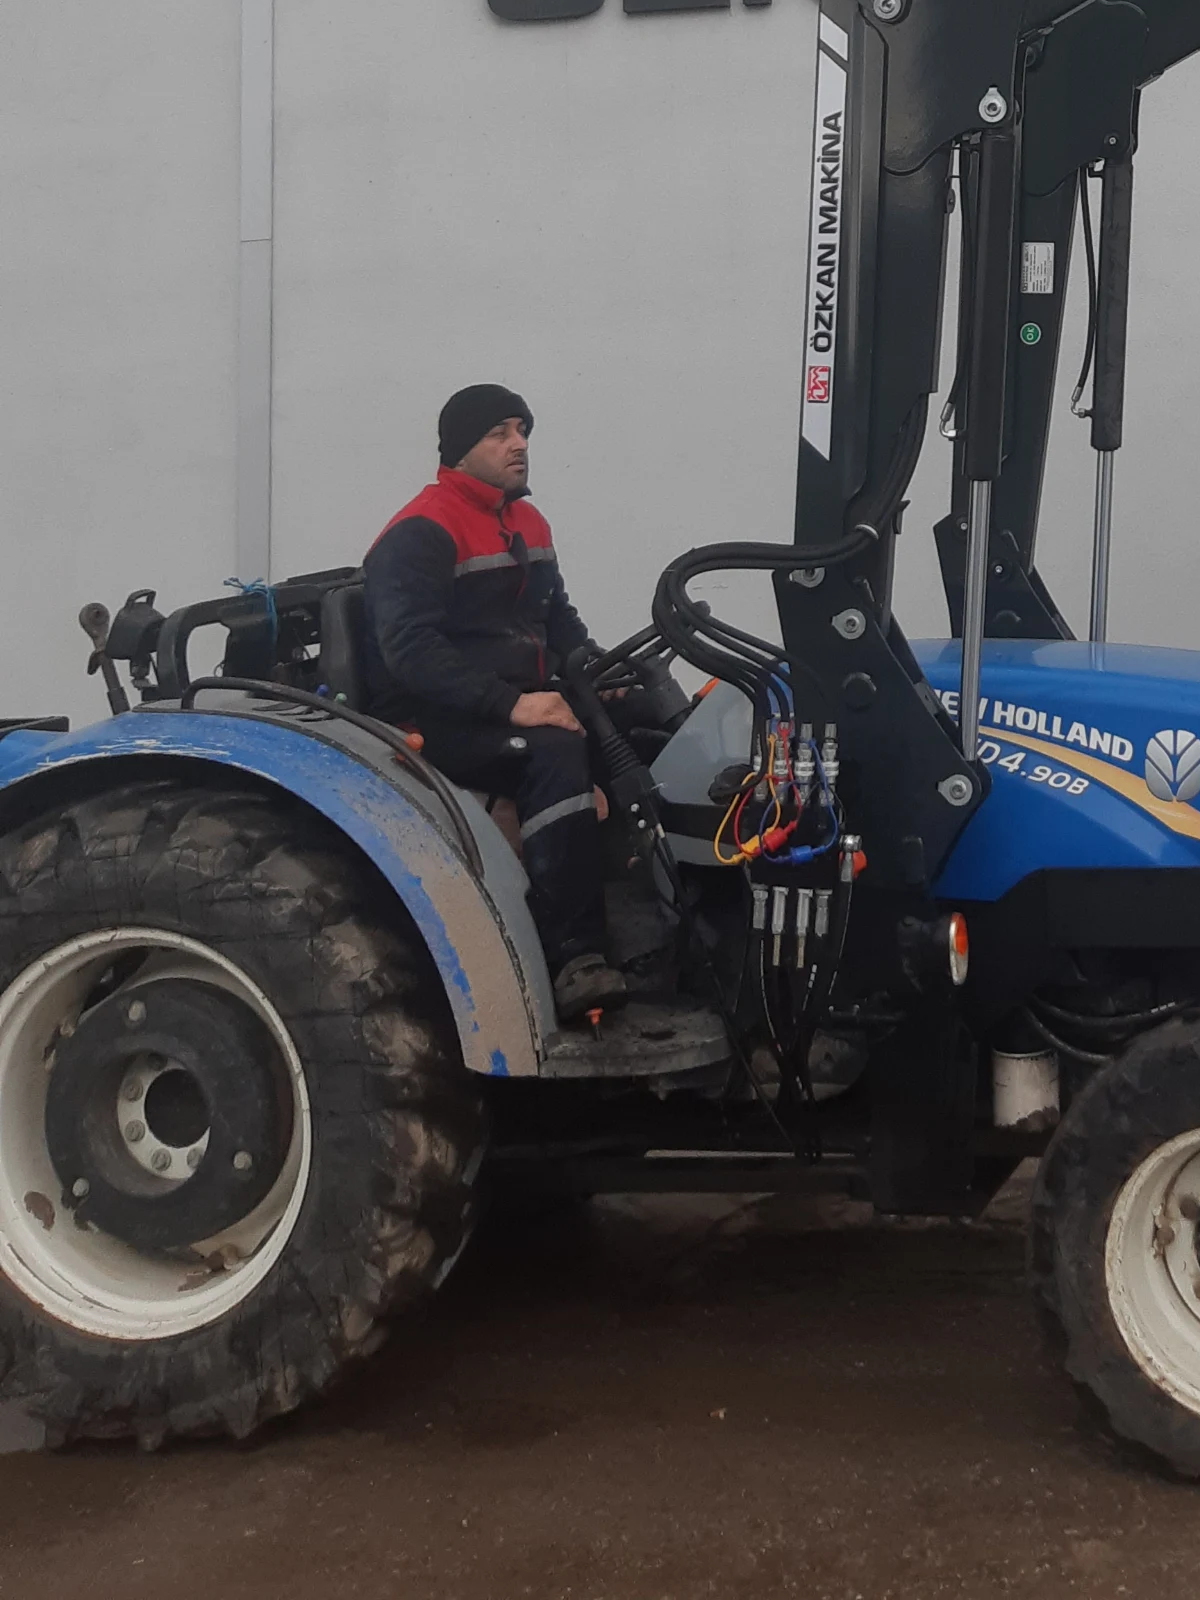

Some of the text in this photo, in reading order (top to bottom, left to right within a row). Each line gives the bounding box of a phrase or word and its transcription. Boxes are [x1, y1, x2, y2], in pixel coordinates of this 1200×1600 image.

[816, 110, 844, 235] MAKİNA
[809, 242, 838, 353] ÖZKAN
[1026, 326, 1035, 341] OK
[993, 700, 1134, 762] HOLLAND
[976, 738, 1090, 796] D4.90B
